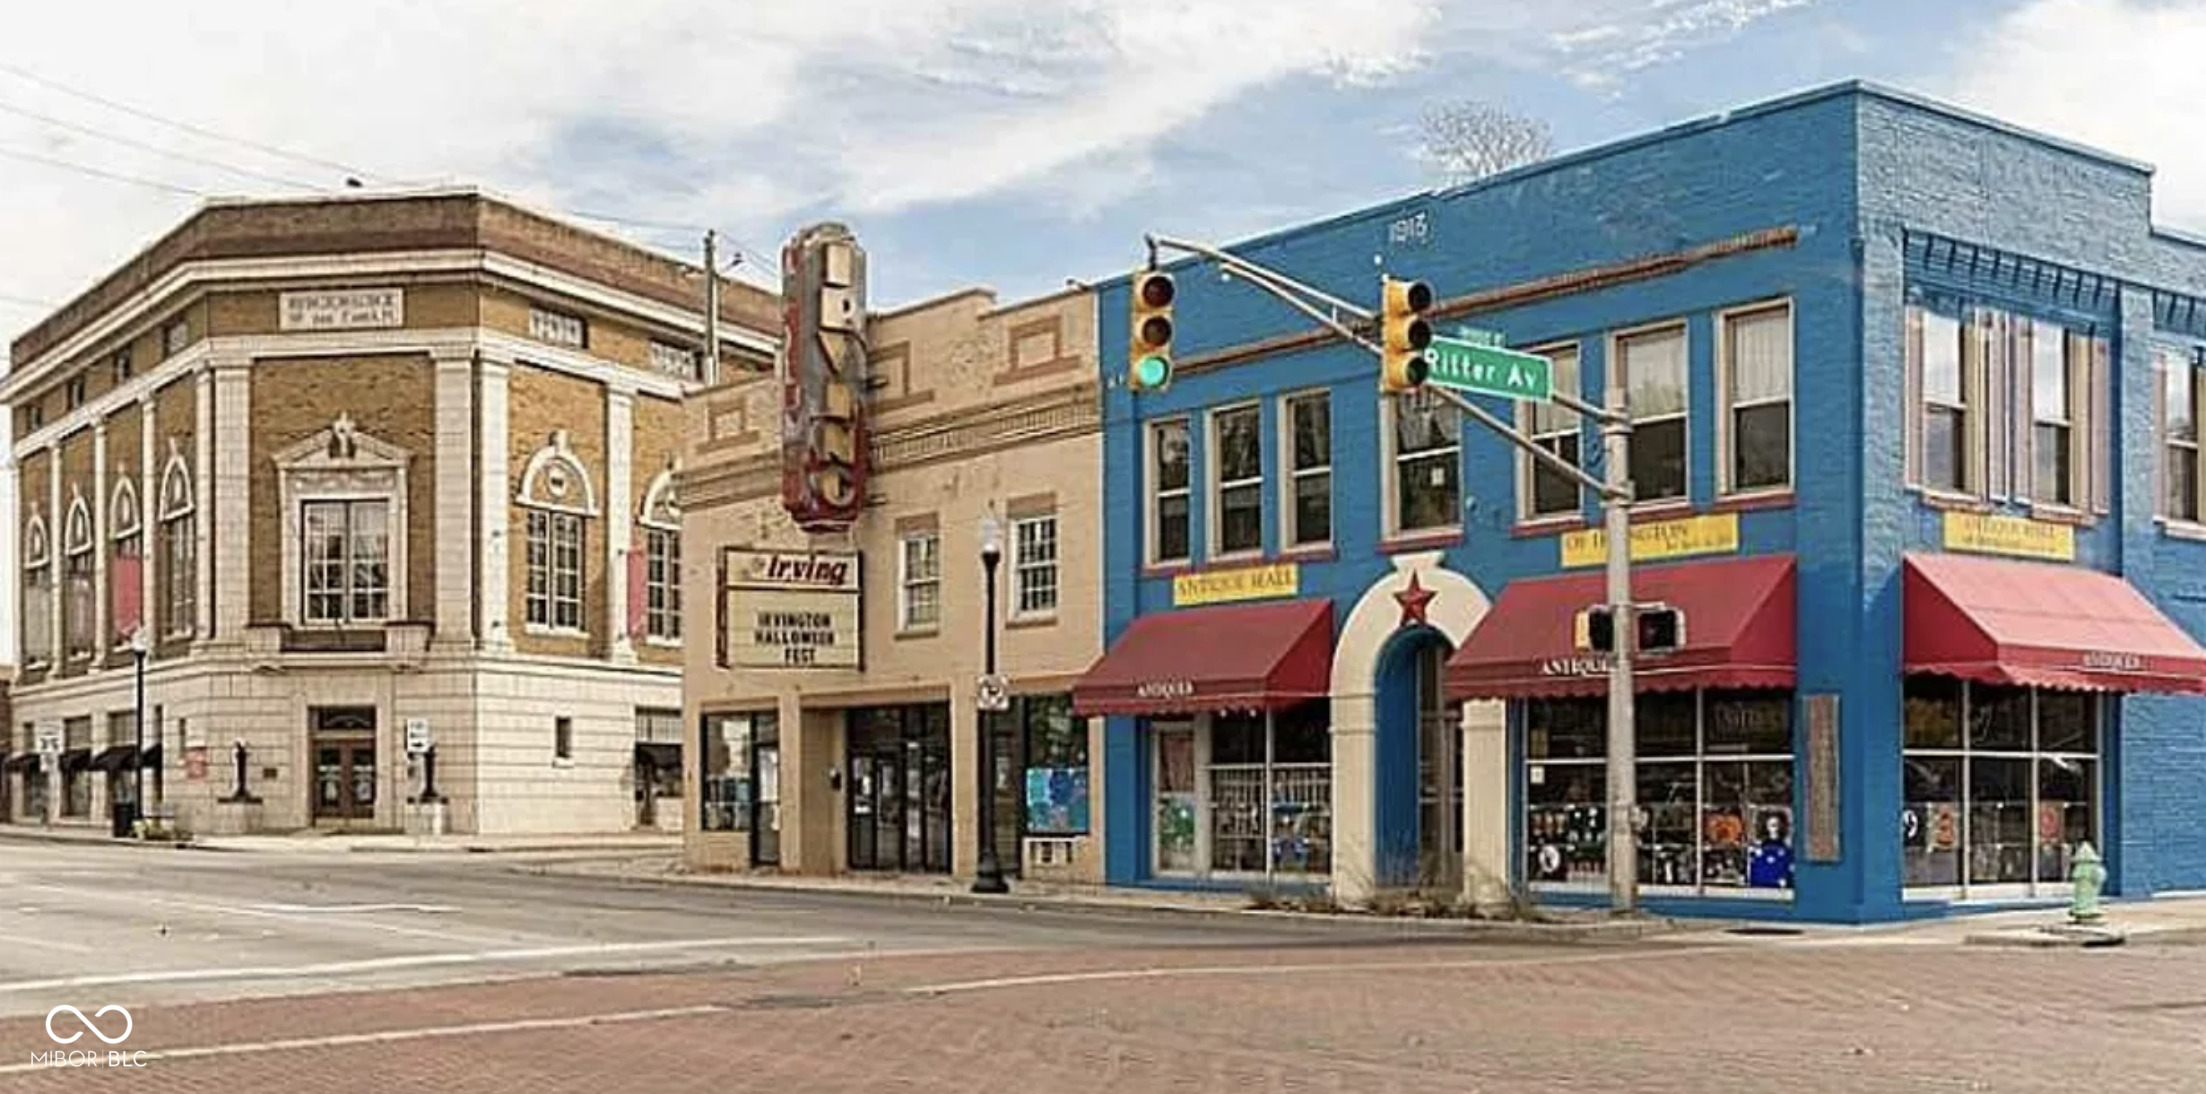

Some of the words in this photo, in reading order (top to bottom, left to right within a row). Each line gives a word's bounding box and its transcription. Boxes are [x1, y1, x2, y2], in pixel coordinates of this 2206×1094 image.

[1424, 349, 1495, 382] Ritter
[1508, 363, 1539, 388] Av
[767, 554, 848, 585] Irving
[785, 648, 815, 663] FEST
